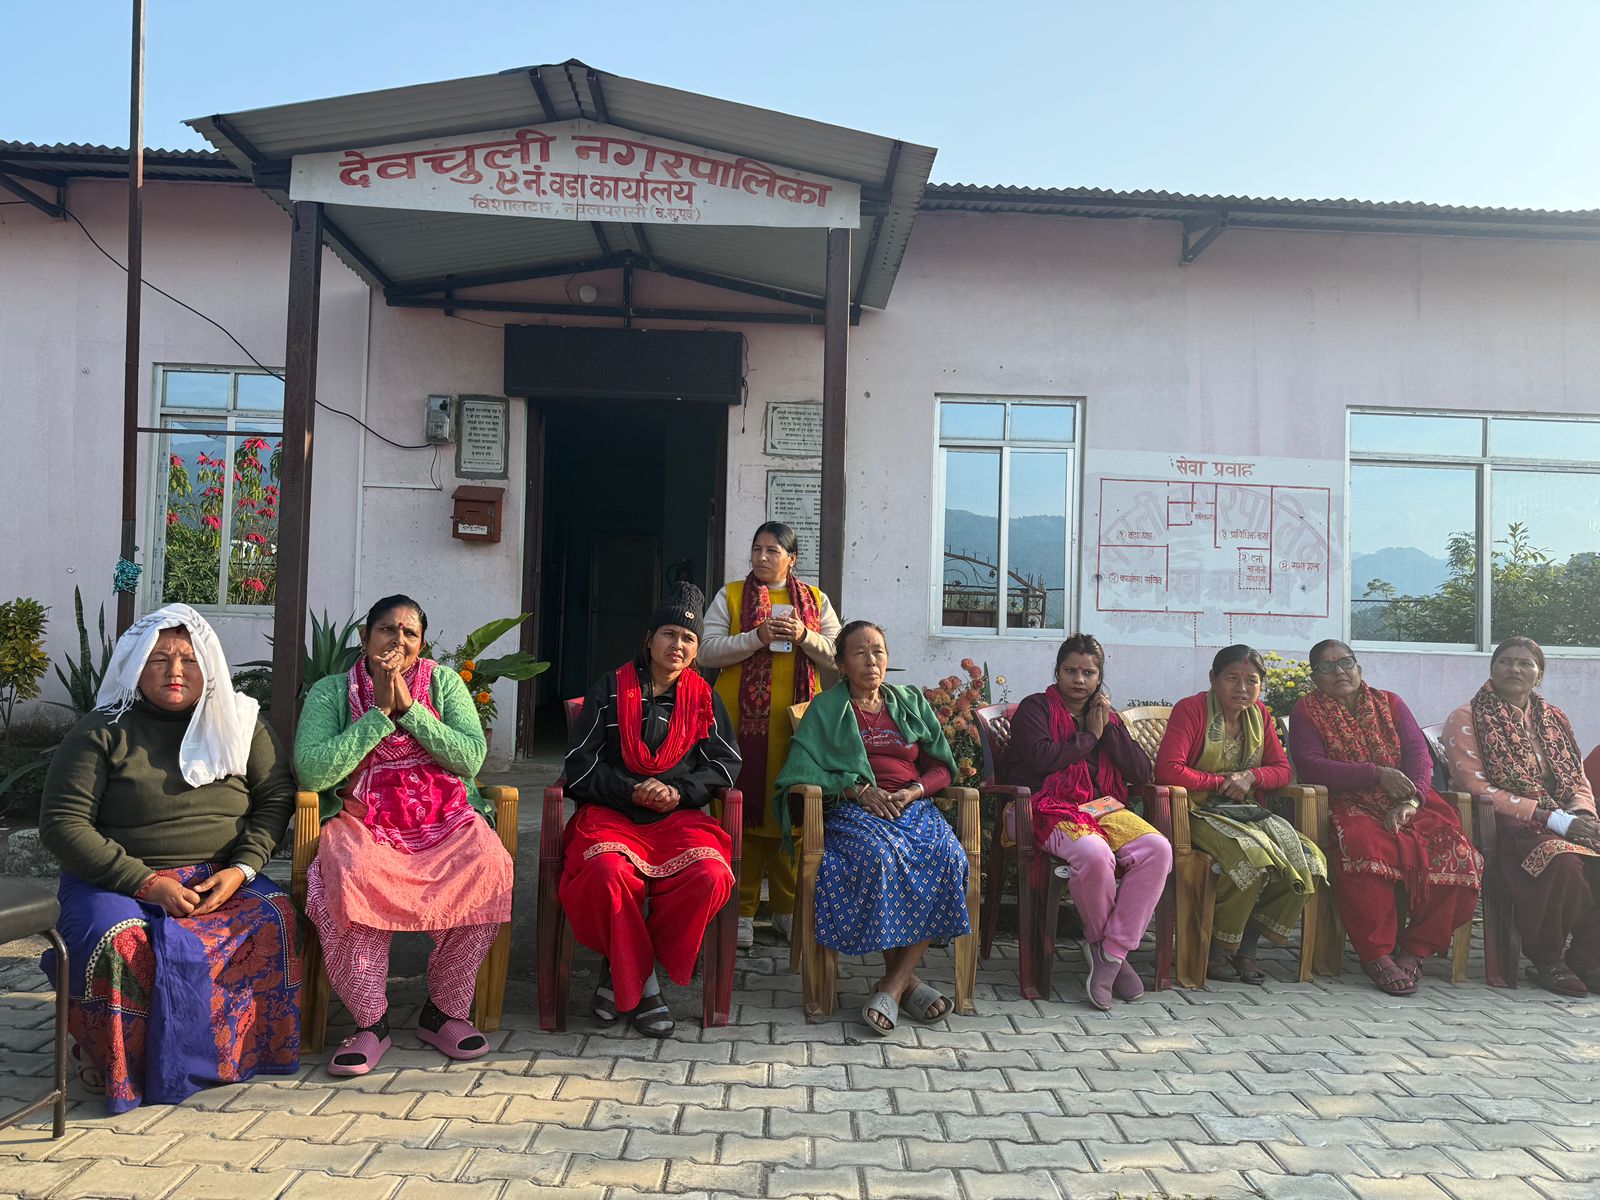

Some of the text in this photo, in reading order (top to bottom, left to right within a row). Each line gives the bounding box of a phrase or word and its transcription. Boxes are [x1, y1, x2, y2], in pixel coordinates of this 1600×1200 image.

[338, 128, 833, 207] देवचुली नगरपालिका
[590, 170, 697, 205] कार्यालय
[1176, 456, 1255, 478] सेवा प्रवाह
